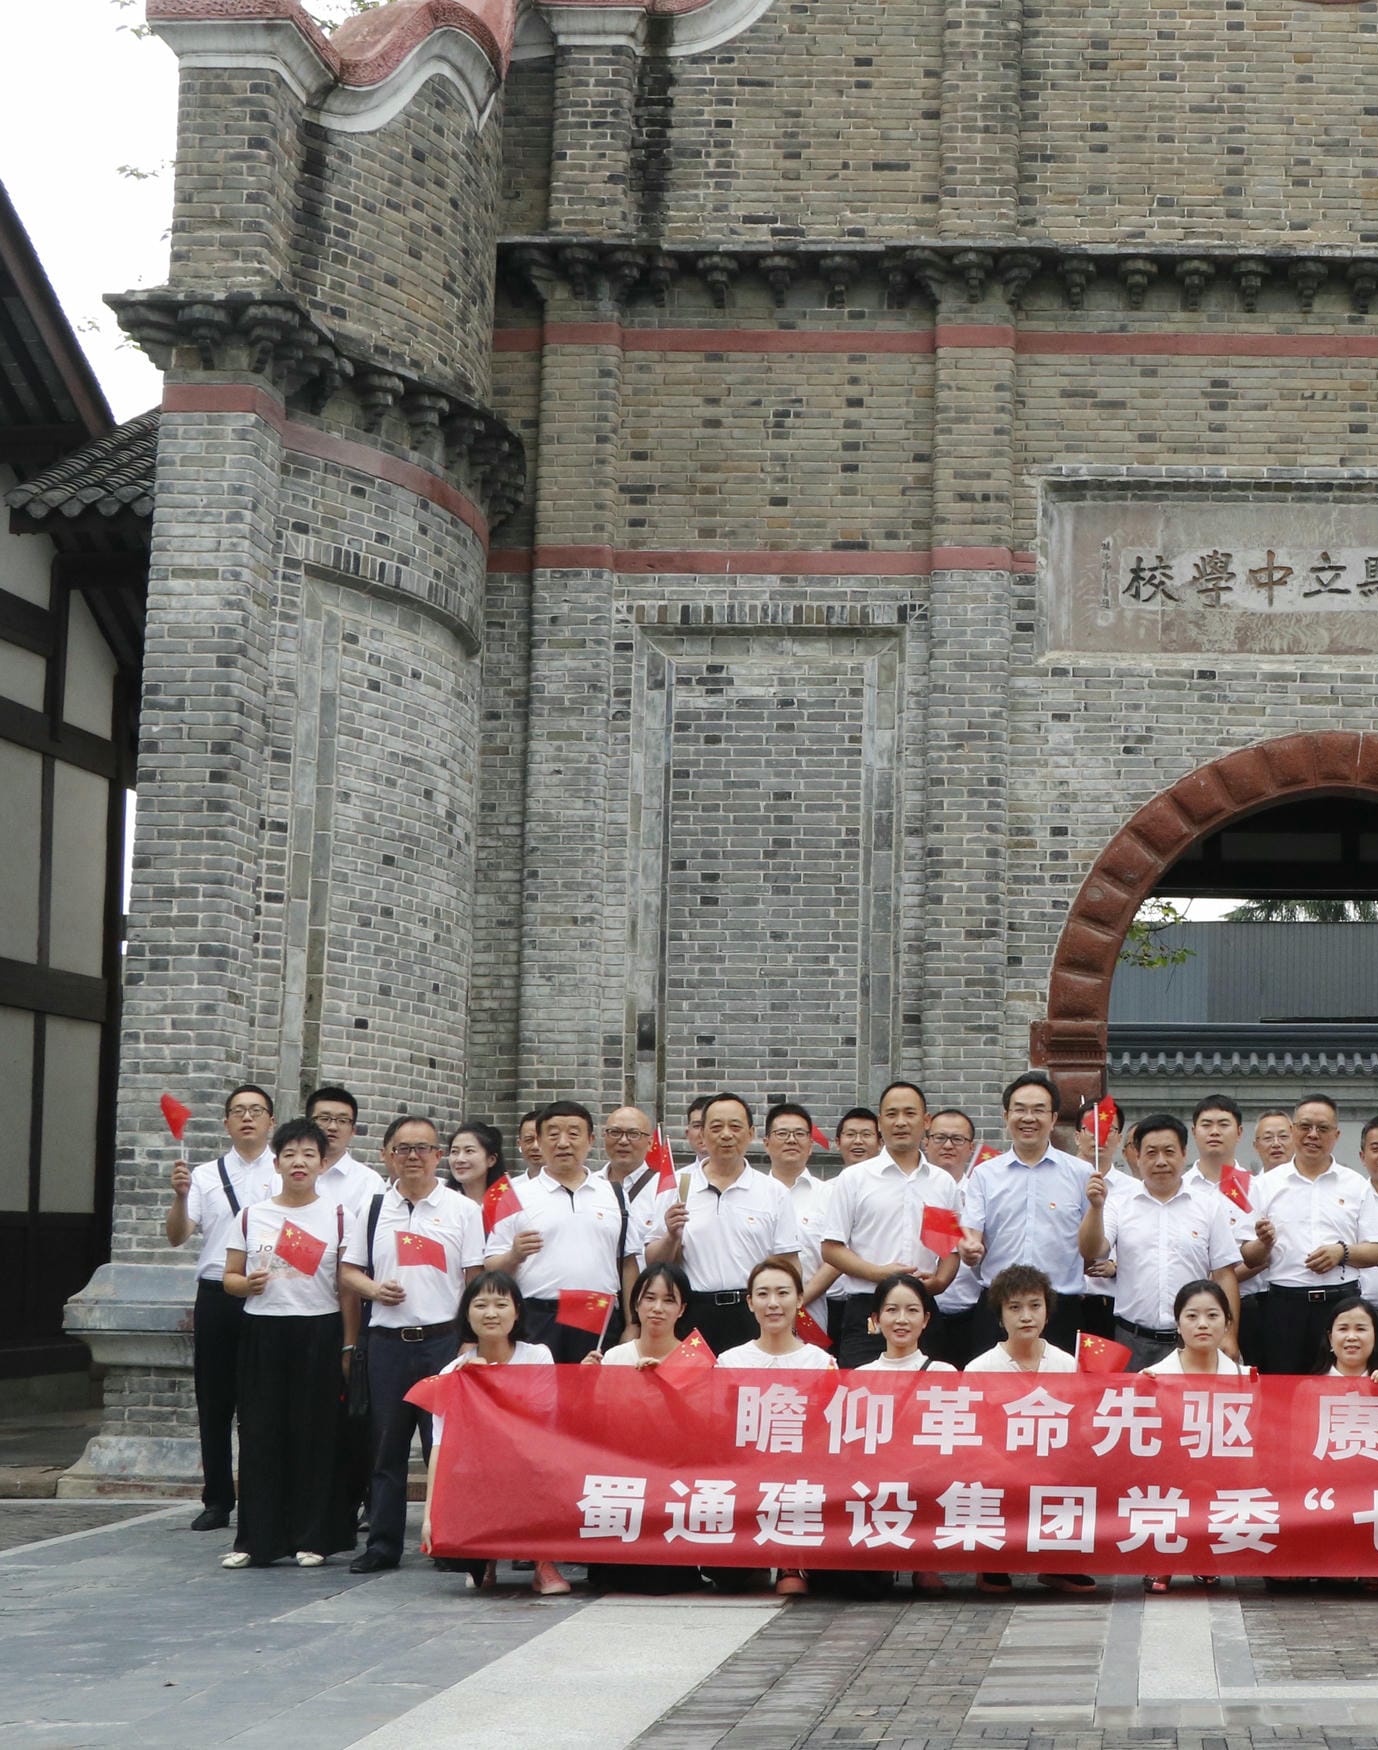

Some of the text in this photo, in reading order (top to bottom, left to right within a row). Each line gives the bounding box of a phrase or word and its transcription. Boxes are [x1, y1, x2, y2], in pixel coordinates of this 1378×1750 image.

[735, 1383, 1254, 1459] 瞻仰革命先驱
